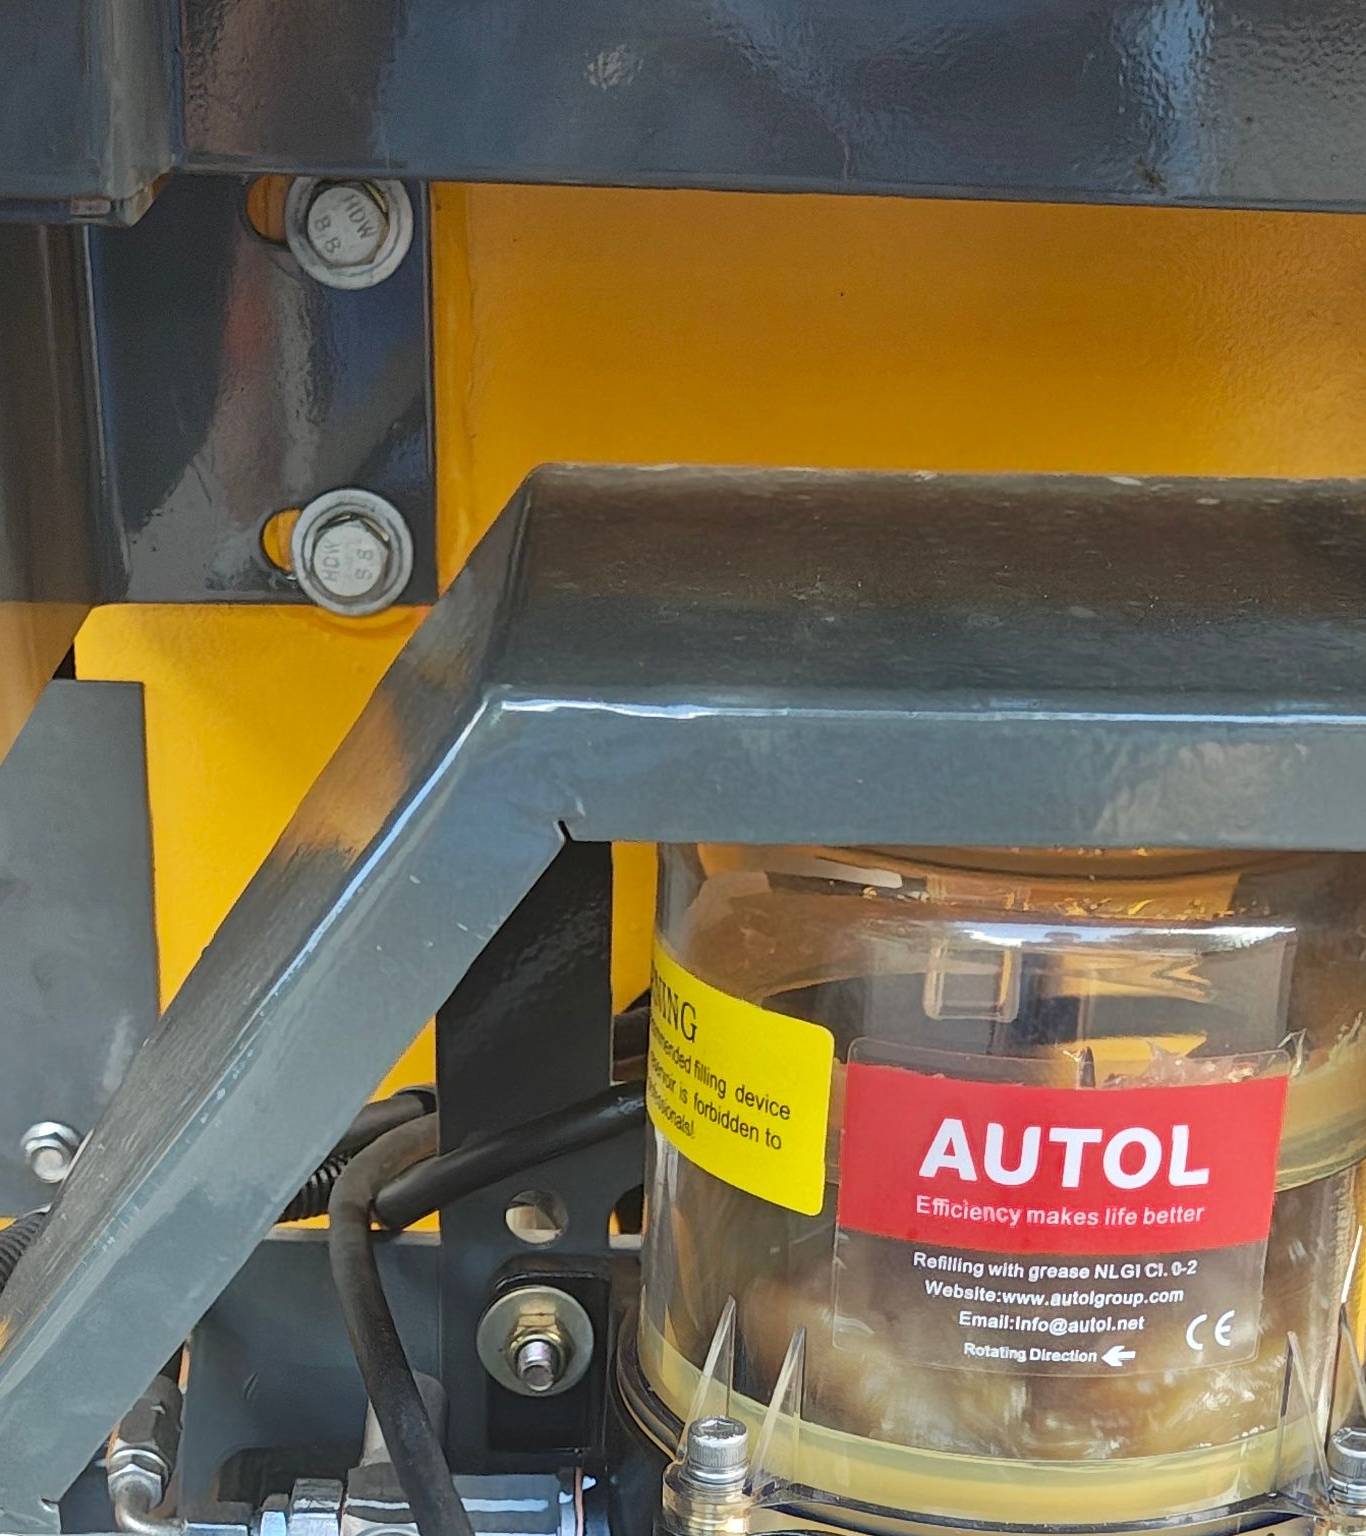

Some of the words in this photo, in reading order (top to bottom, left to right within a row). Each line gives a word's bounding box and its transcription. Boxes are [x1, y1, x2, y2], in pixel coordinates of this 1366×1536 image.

[694, 1060, 726, 1100] filling
[735, 1084, 791, 1120] device
[679, 1080, 689, 1105] is
[694, 1091, 760, 1142] forbidden
[765, 1127, 783, 1151] to
[918, 1117, 1210, 1190] AUTOL
[916, 1194, 1021, 1228] Efficiency
[1027, 1207, 1099, 1227] makes
[1104, 1206, 1137, 1227] life
[1142, 1205, 1206, 1226] better
[913, 1251, 984, 1277] Refilling
[988, 1261, 1025, 1279] with
[1028, 1265, 1091, 1282] grease
[1094, 1263, 1141, 1280] NLGI
[1171, 1259, 1199, 1276] 0-2
[924, 1279, 1185, 1308] Website:www.autolgroup.com
[1185, 1309, 1236, 1351] CE
[963, 1342, 1027, 1362] Rotating
[1029, 1347, 1098, 1363] Direction
